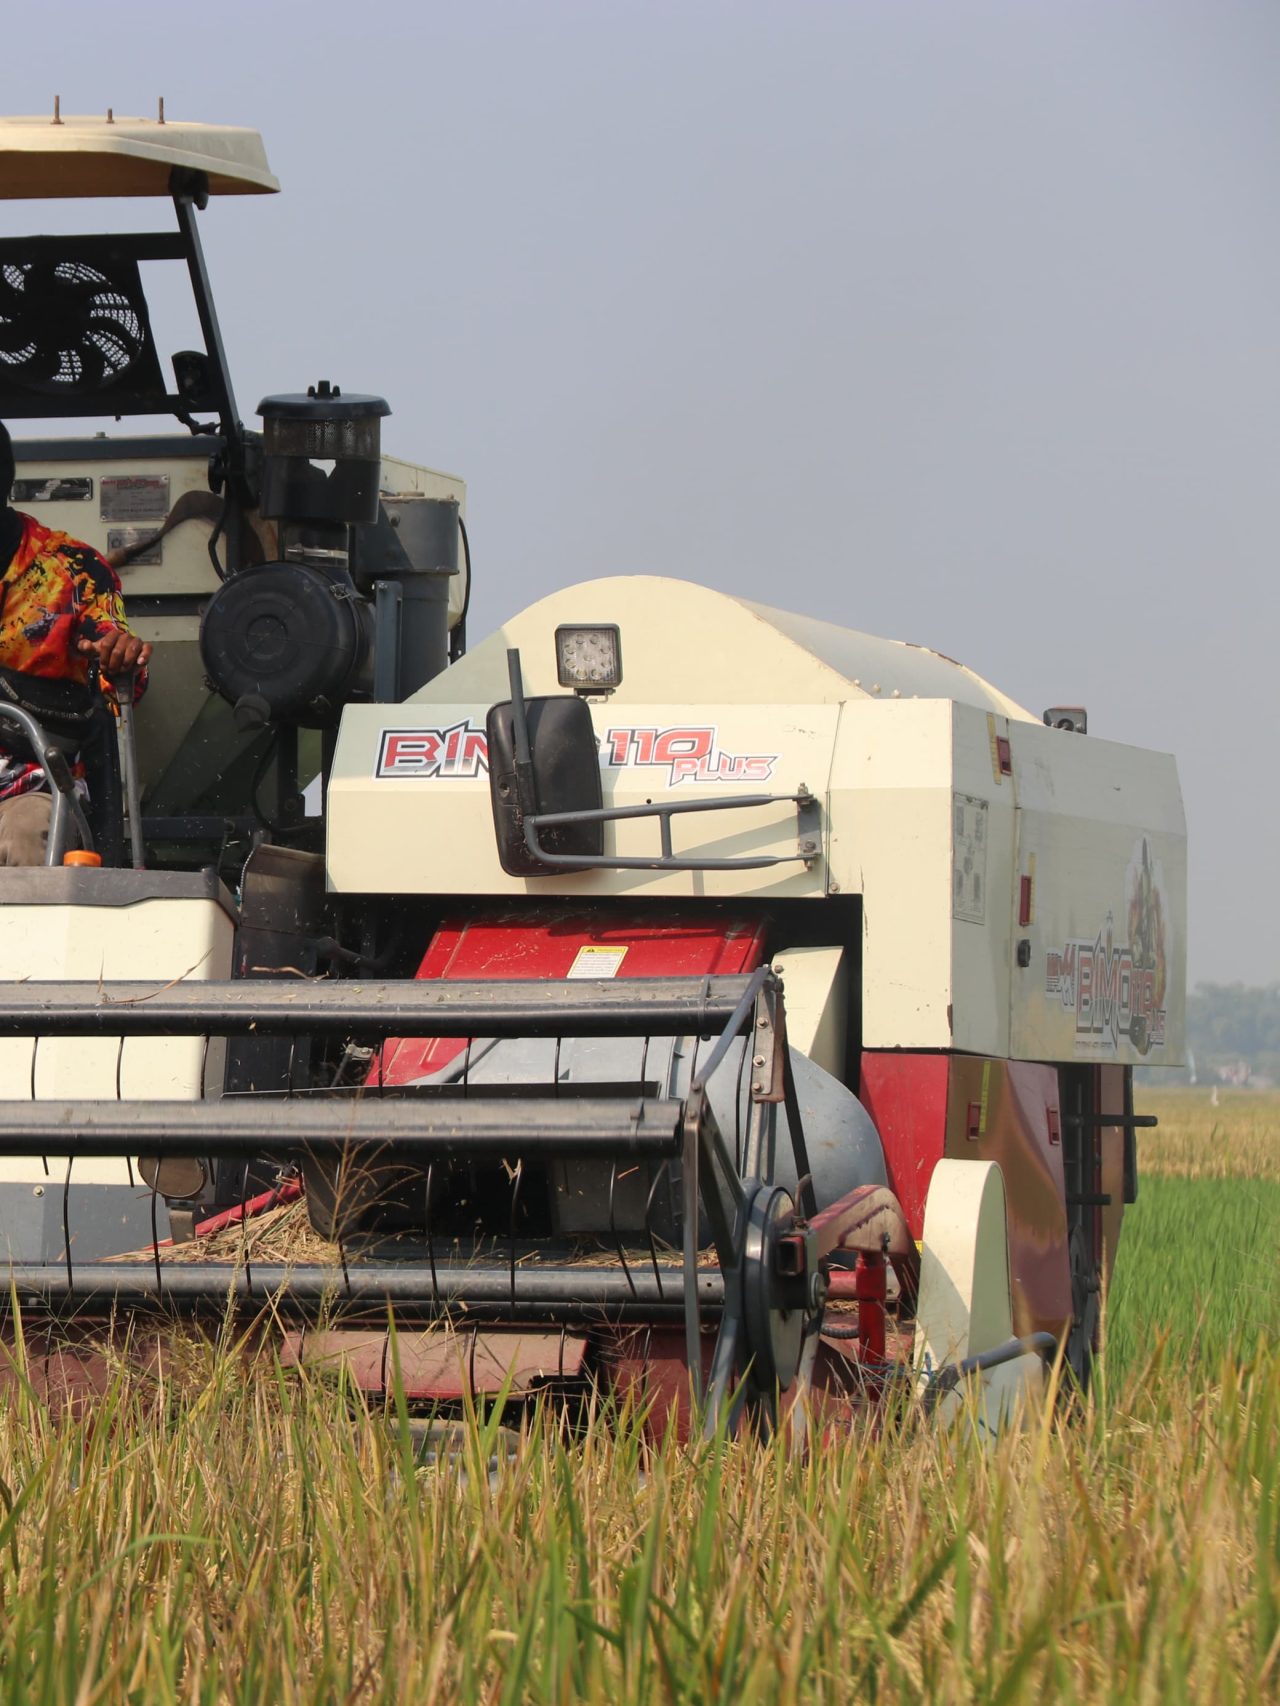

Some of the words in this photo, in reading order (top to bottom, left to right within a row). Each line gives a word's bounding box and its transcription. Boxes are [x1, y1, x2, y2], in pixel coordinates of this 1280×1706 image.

[607, 728, 716, 766] 110
[669, 751, 778, 787] PLUS
[1076, 937, 1133, 1046] BIMO
